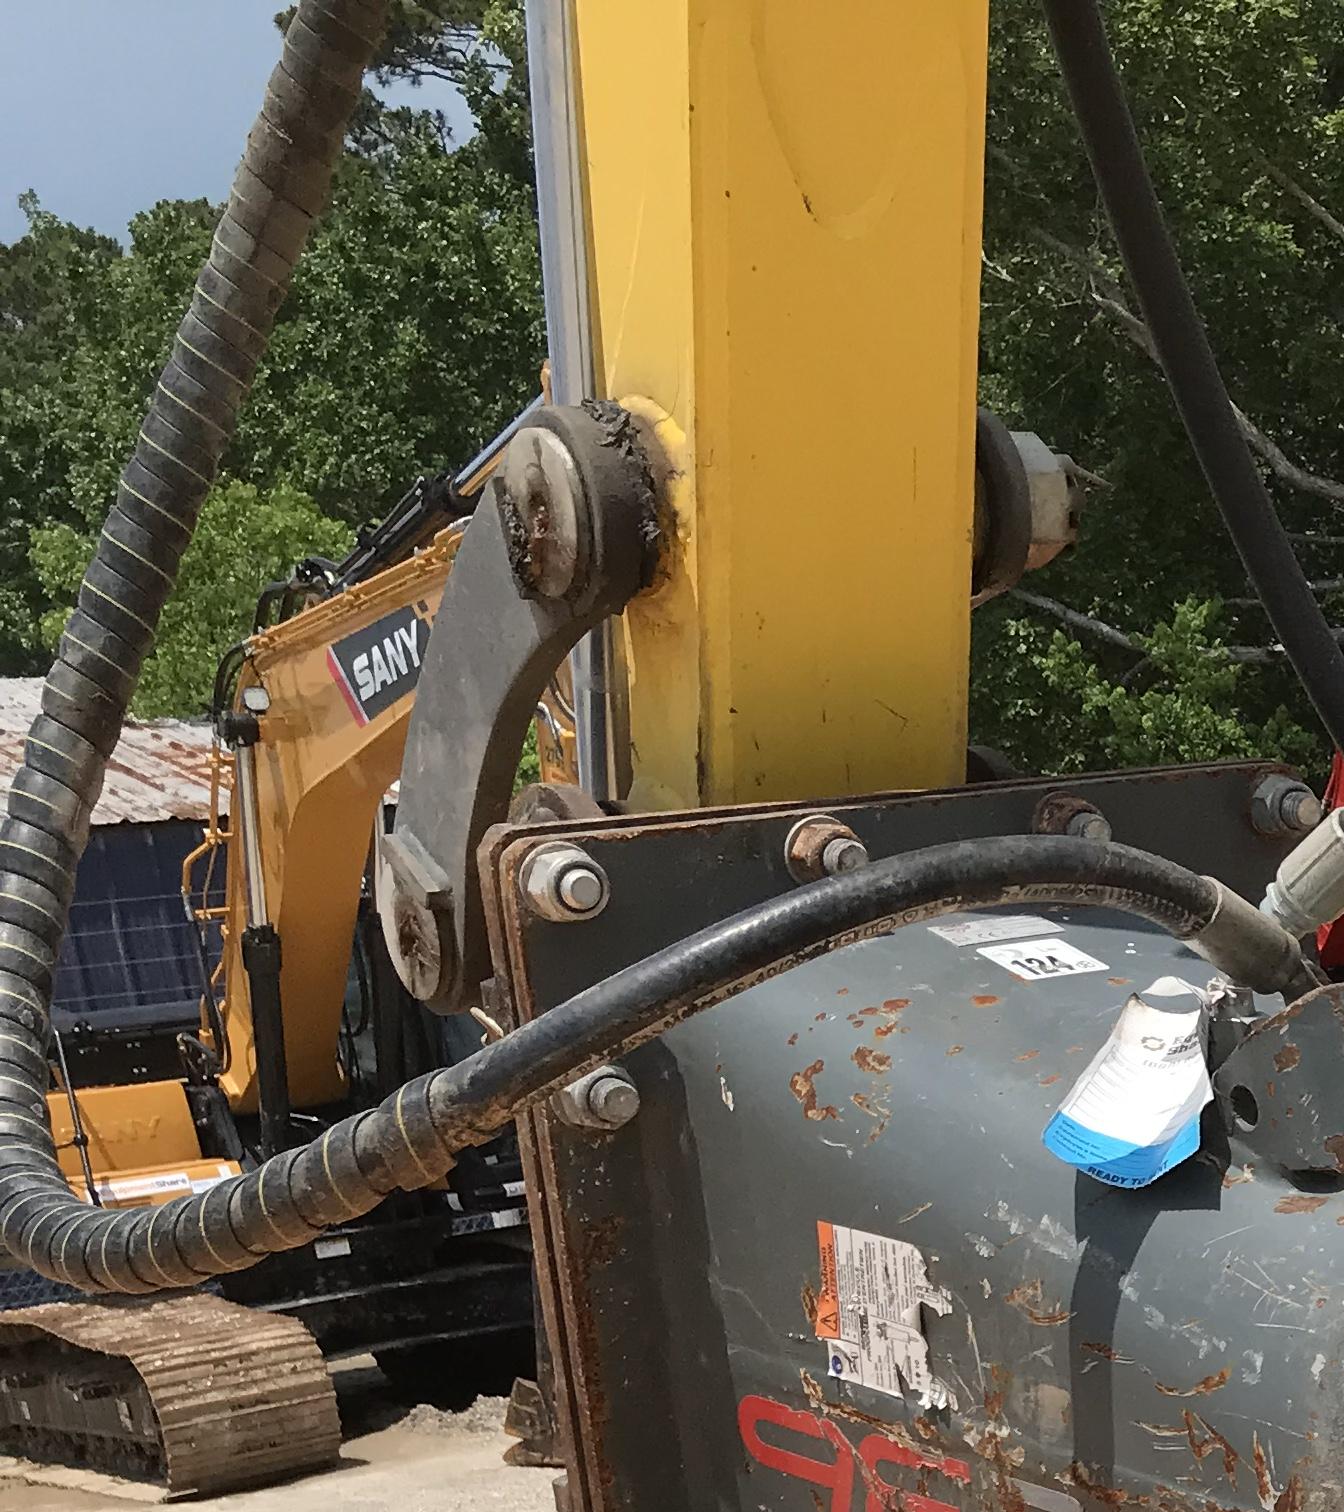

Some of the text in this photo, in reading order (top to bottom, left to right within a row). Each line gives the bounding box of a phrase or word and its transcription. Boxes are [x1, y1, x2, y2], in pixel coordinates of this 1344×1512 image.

[352, 618, 421, 702] SANY
[1011, 955, 1075, 976] 124
[1086, 1165, 1129, 1186] READY
